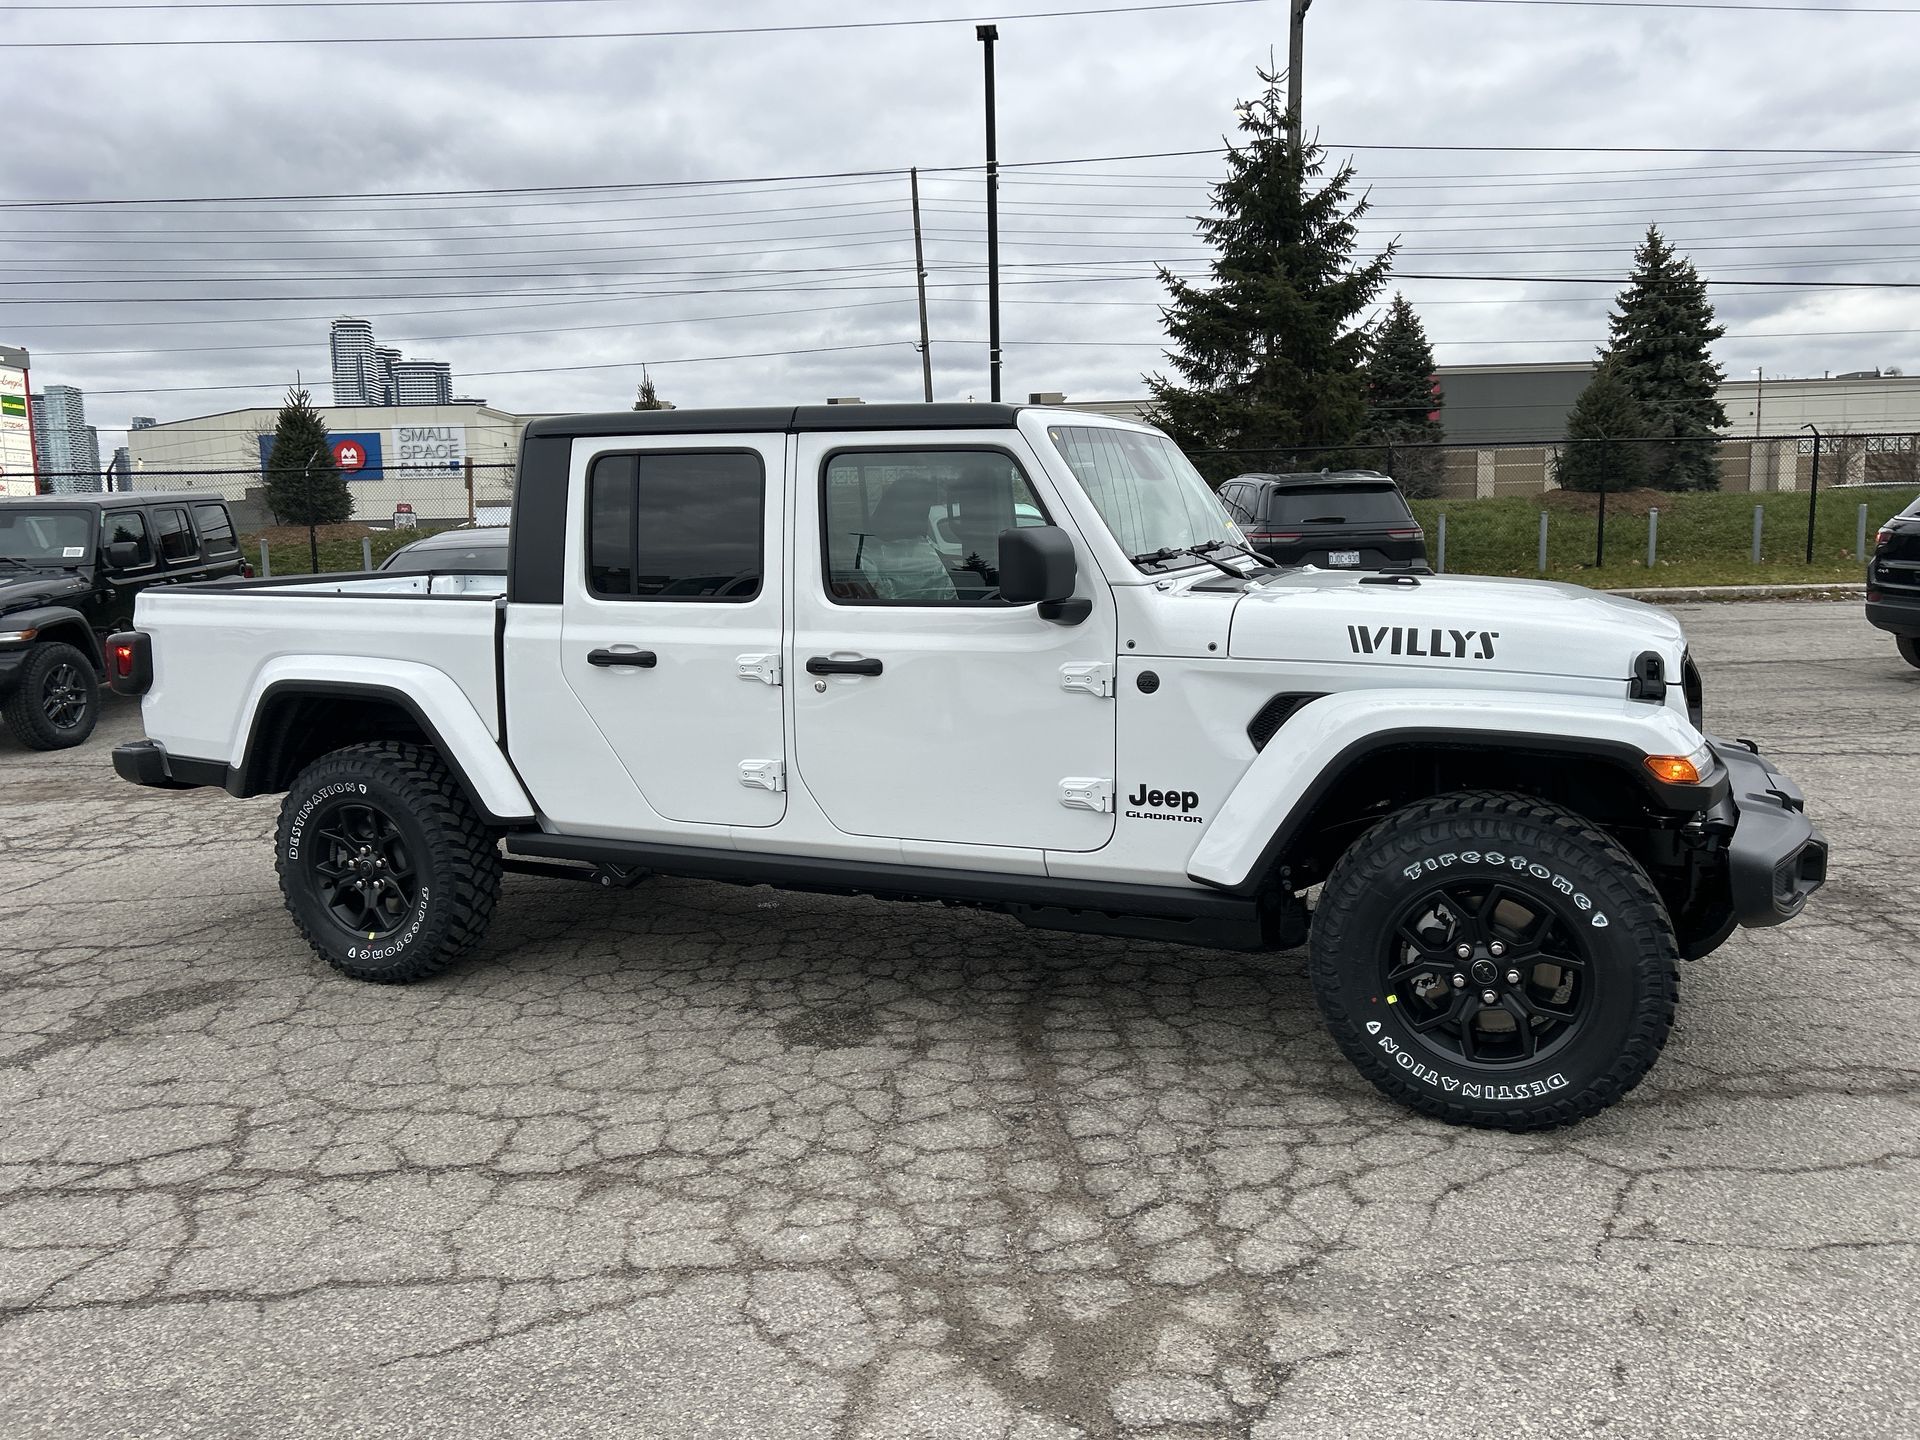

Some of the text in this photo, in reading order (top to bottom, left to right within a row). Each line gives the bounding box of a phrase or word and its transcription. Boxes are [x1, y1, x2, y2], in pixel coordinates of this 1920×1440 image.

[399, 427, 458, 442] SMALL
[400, 444, 460, 459] SPACE
[1347, 624, 1500, 660] WILLYS
[1128, 783, 1199, 813] Jeep
[288, 782, 356, 860] DESTINATION
[1125, 810, 1203, 824] GLADIATOR
[1403, 850, 1593, 910] Firestone
[1378, 1036, 1570, 1100] DESTINATION
